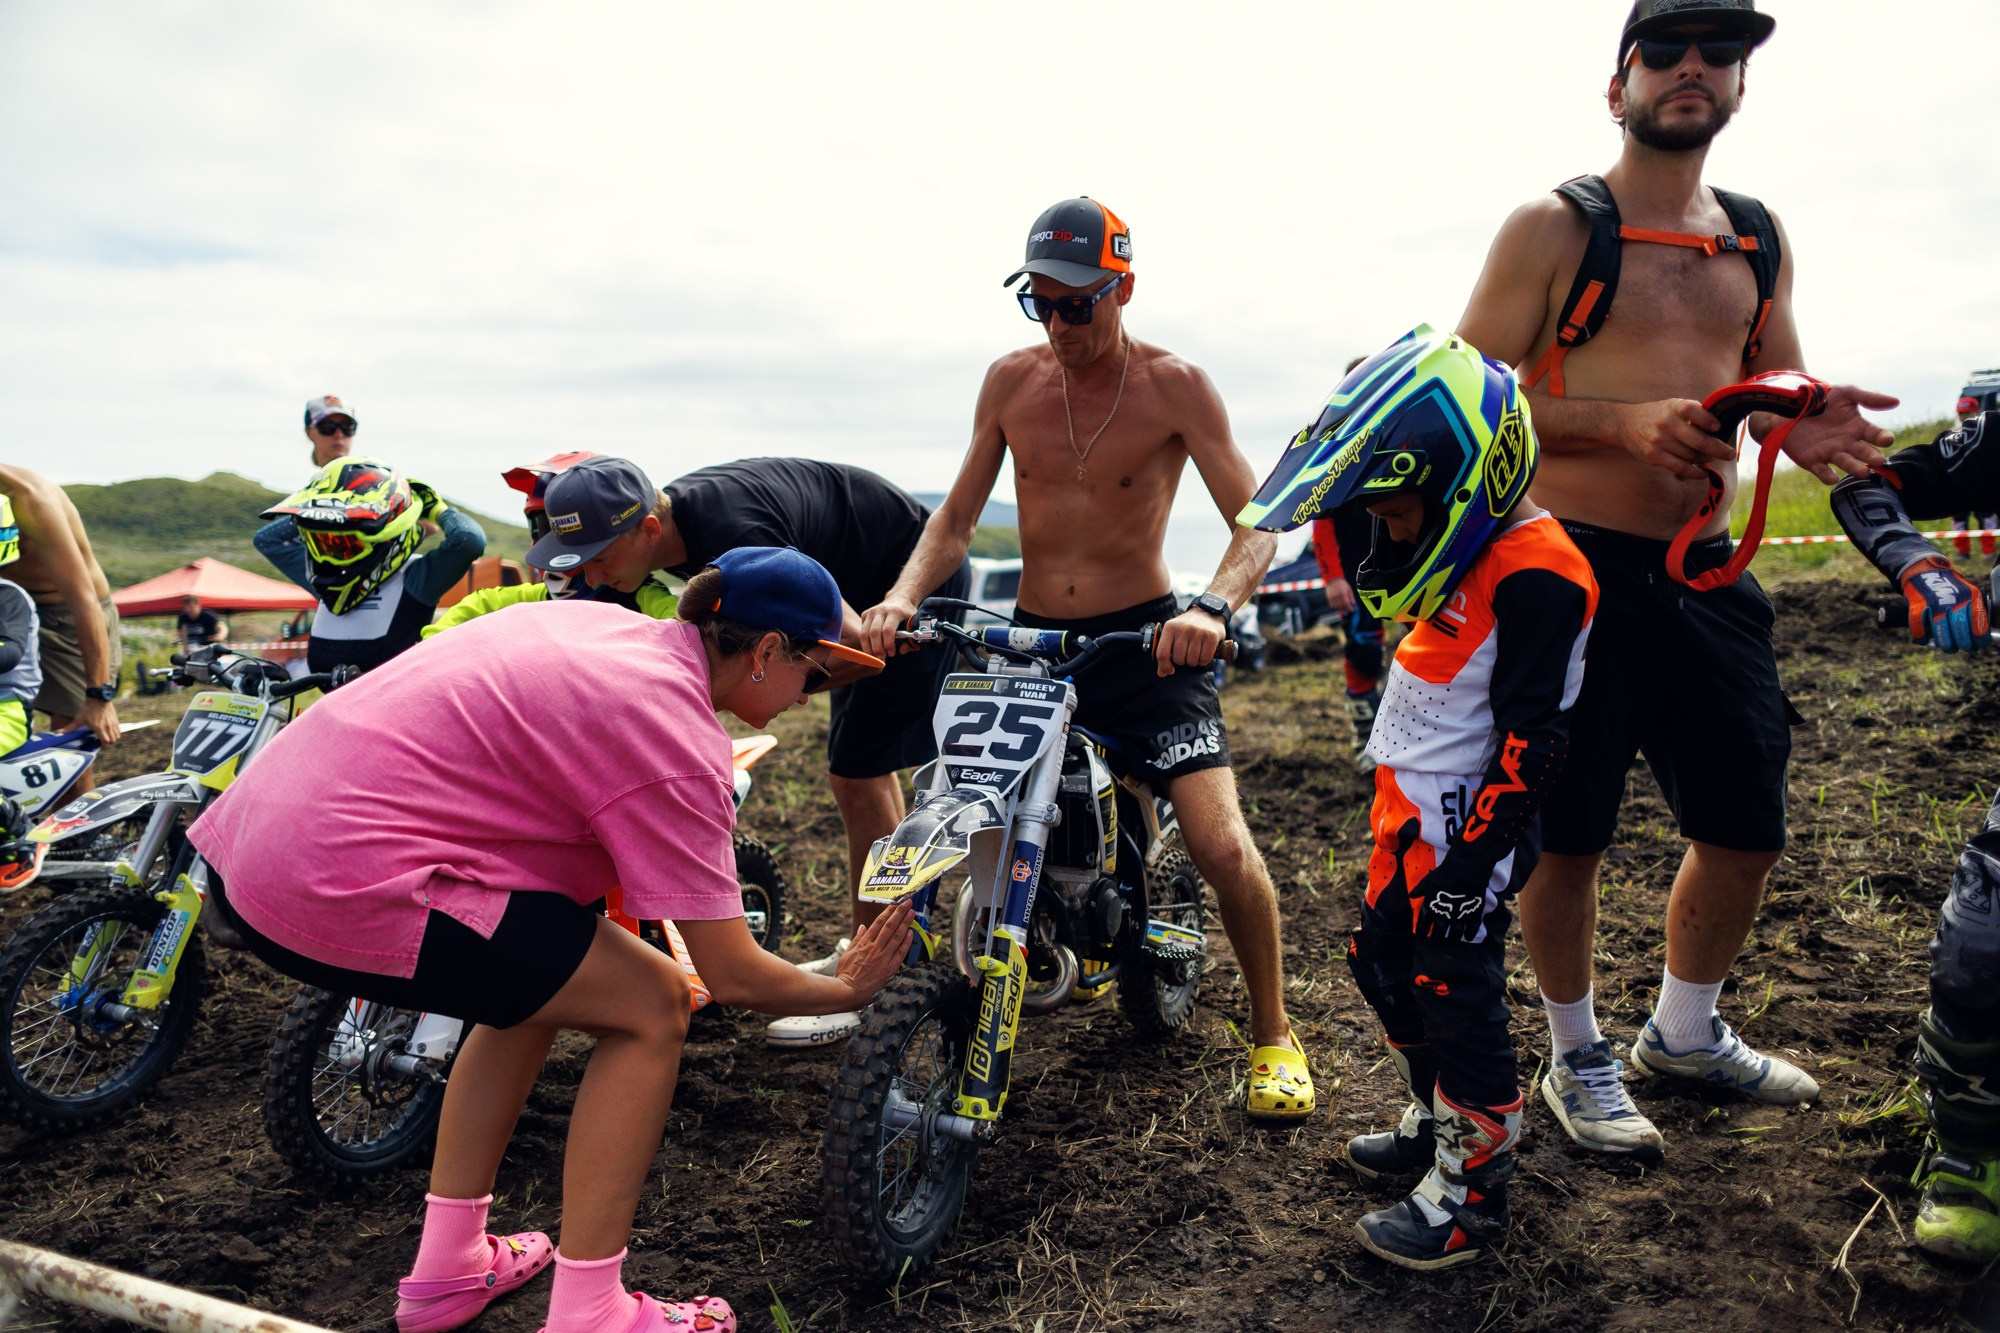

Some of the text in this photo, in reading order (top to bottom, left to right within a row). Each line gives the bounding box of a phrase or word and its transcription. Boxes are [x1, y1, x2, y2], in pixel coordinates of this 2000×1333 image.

[1920, 572, 1959, 605] KTM
[1014, 681, 1057, 692] FADEEV
[1019, 690, 1047, 700] IVAN
[174, 718, 254, 761] 777
[941, 700, 1056, 763] 25
[20, 758, 62, 789] 87
[960, 768, 1004, 784] Eagle
[868, 875, 909, 886] BANANZA
[151, 911, 178, 969] DUNLOP
[167, 919, 187, 956] MOTOREX
[1001, 961, 1023, 1029] Eagle
[809, 1025, 849, 1043] crocs
[1578, 1044, 1594, 1055] 998
